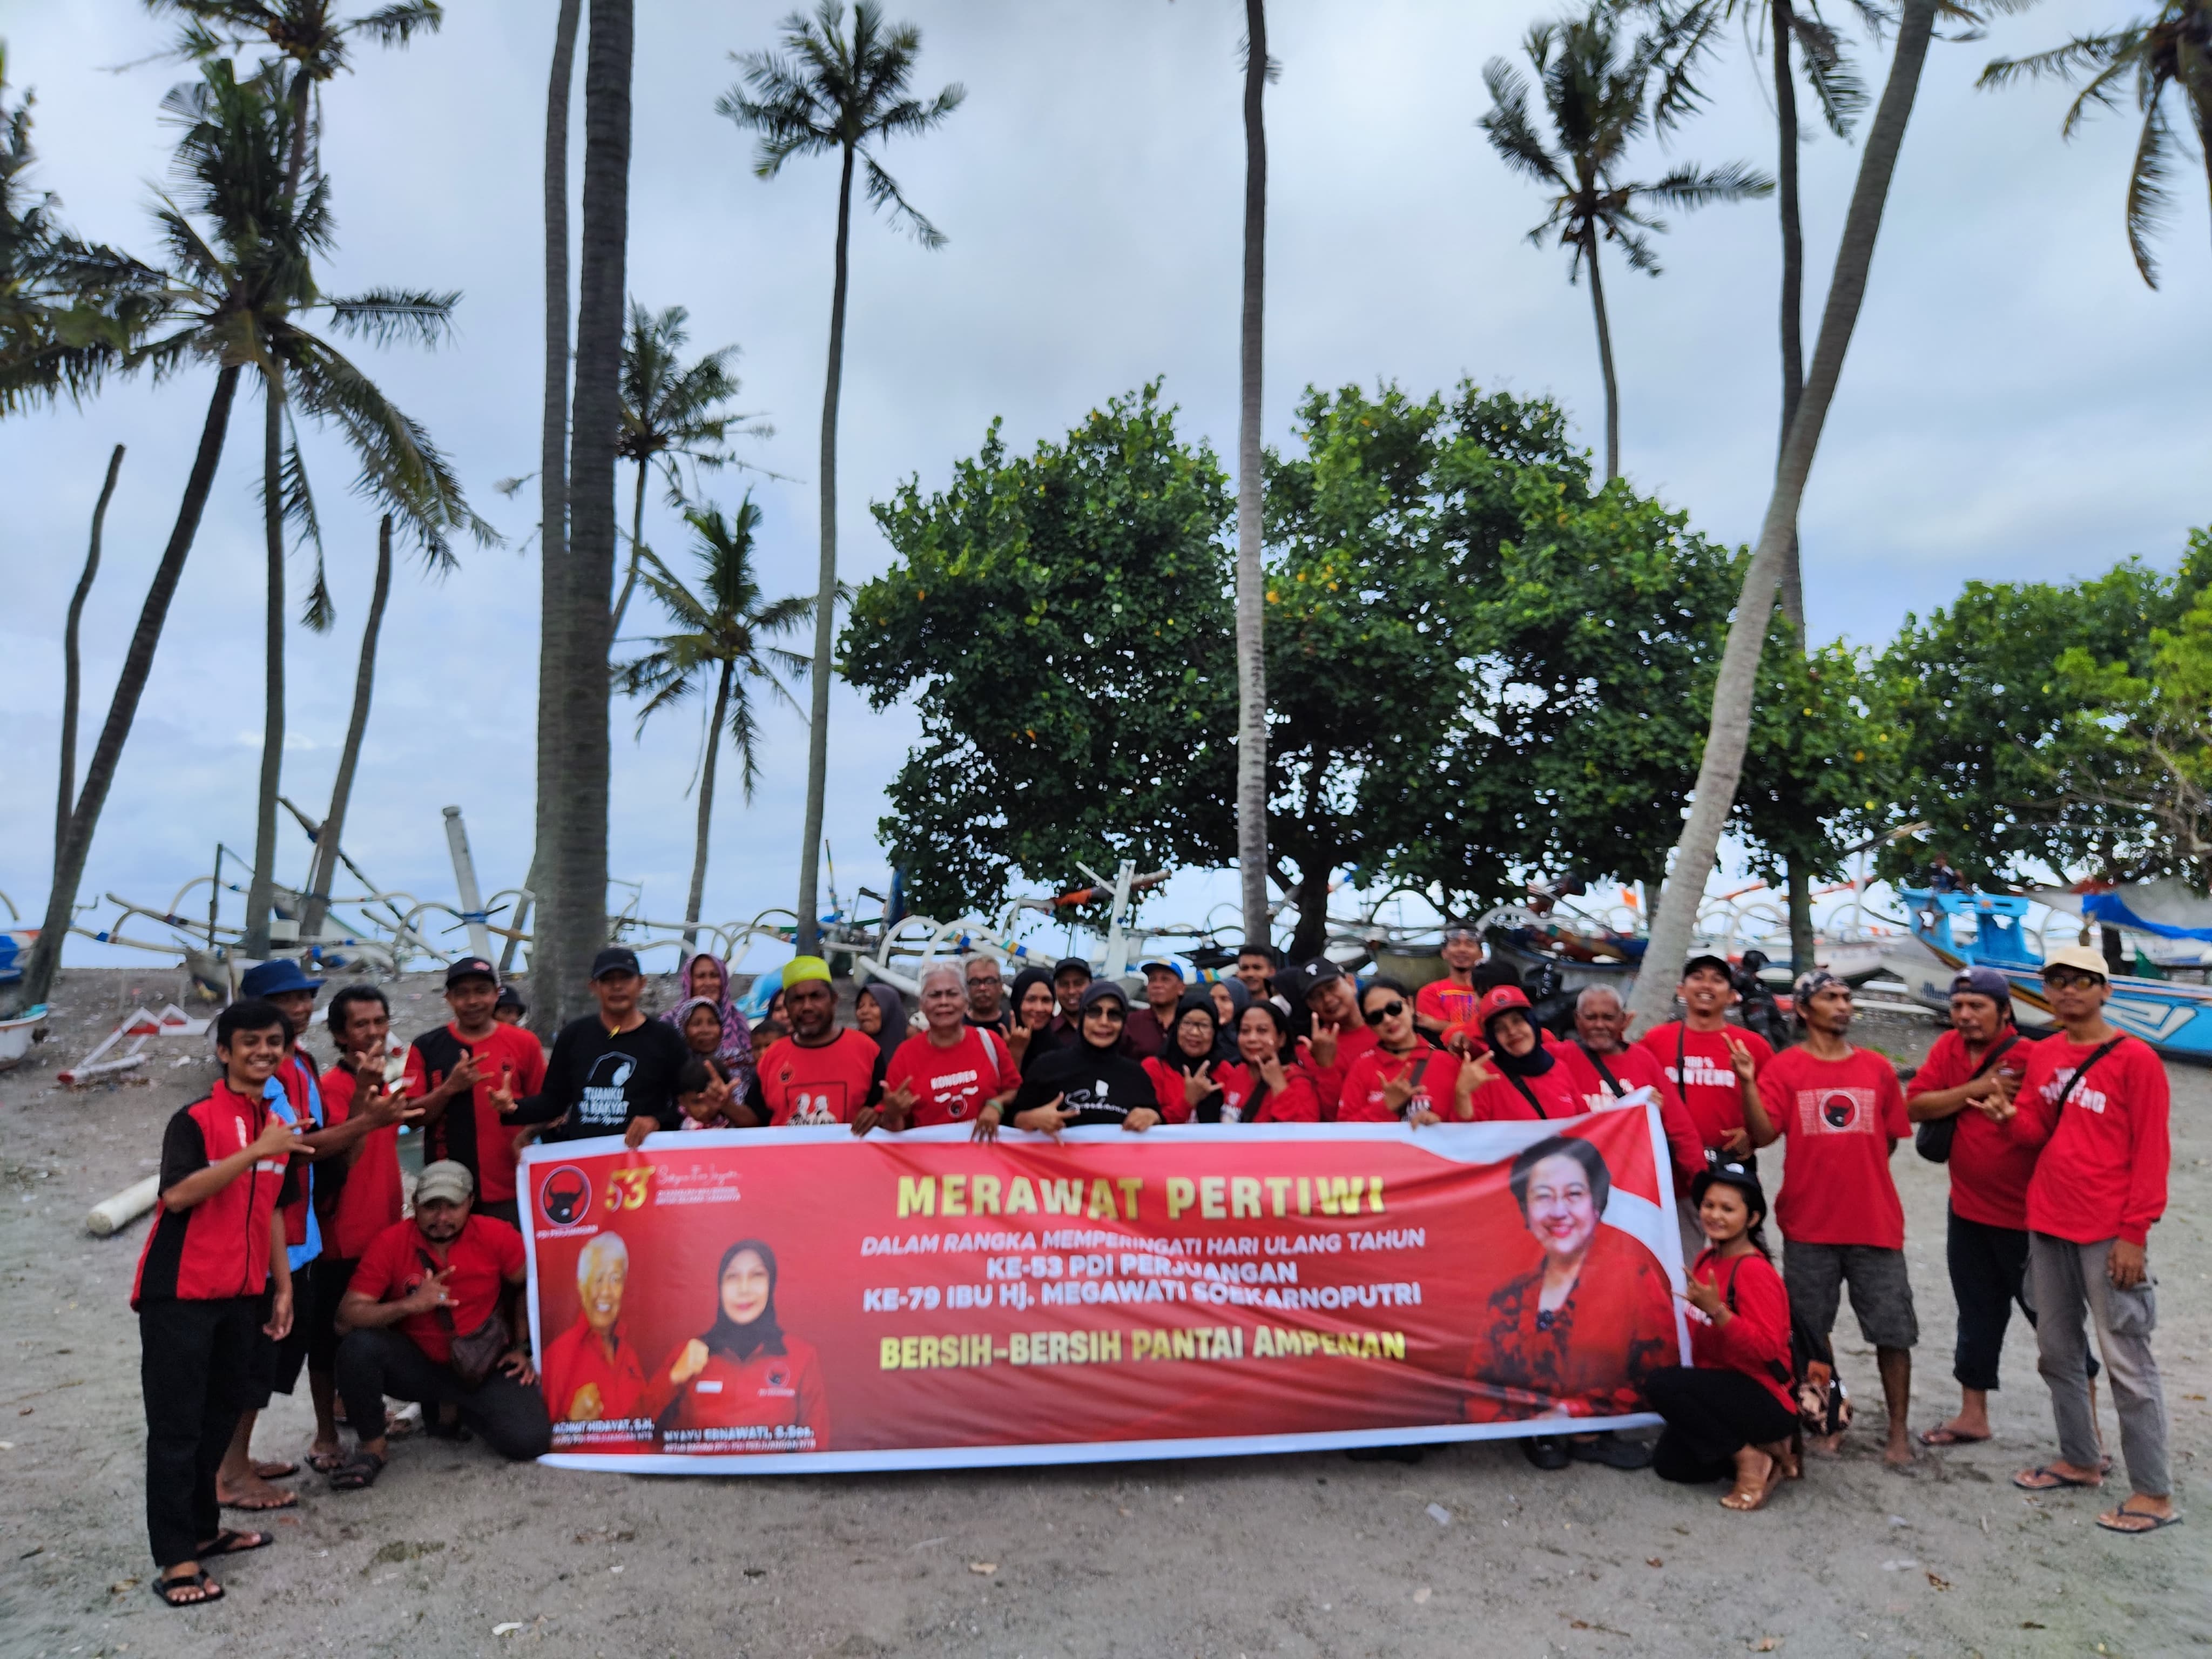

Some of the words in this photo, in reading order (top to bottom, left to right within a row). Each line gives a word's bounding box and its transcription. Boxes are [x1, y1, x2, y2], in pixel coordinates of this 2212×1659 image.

[896, 1174, 1143, 1220] MERAWAT
[1166, 1176, 1385, 1219] PERTIWI
[861, 1234, 940, 1256] DALAM
[943, 1231, 1036, 1252] RANGKA
[1042, 1230, 1202, 1255] MEMPERINGATI
[1206, 1236, 1259, 1255] HARI
[1264, 1232, 1341, 1255] ULANG
[1347, 1227, 1425, 1251] TAHUN
[987, 1256, 1063, 1280] KE-53
[1069, 1253, 1114, 1278] PDI
[1120, 1253, 1298, 1284] PERJUANGAN
[862, 1286, 941, 1312] KE-79
[946, 1284, 993, 1309] IBU
[1041, 1279, 1187, 1305] MEGAWATI
[1191, 1281, 1422, 1310] SOEKARNOPUTRI
[880, 1330, 1122, 1370] BERSIH-BERSIH
[1131, 1326, 1243, 1361] PANTAI
